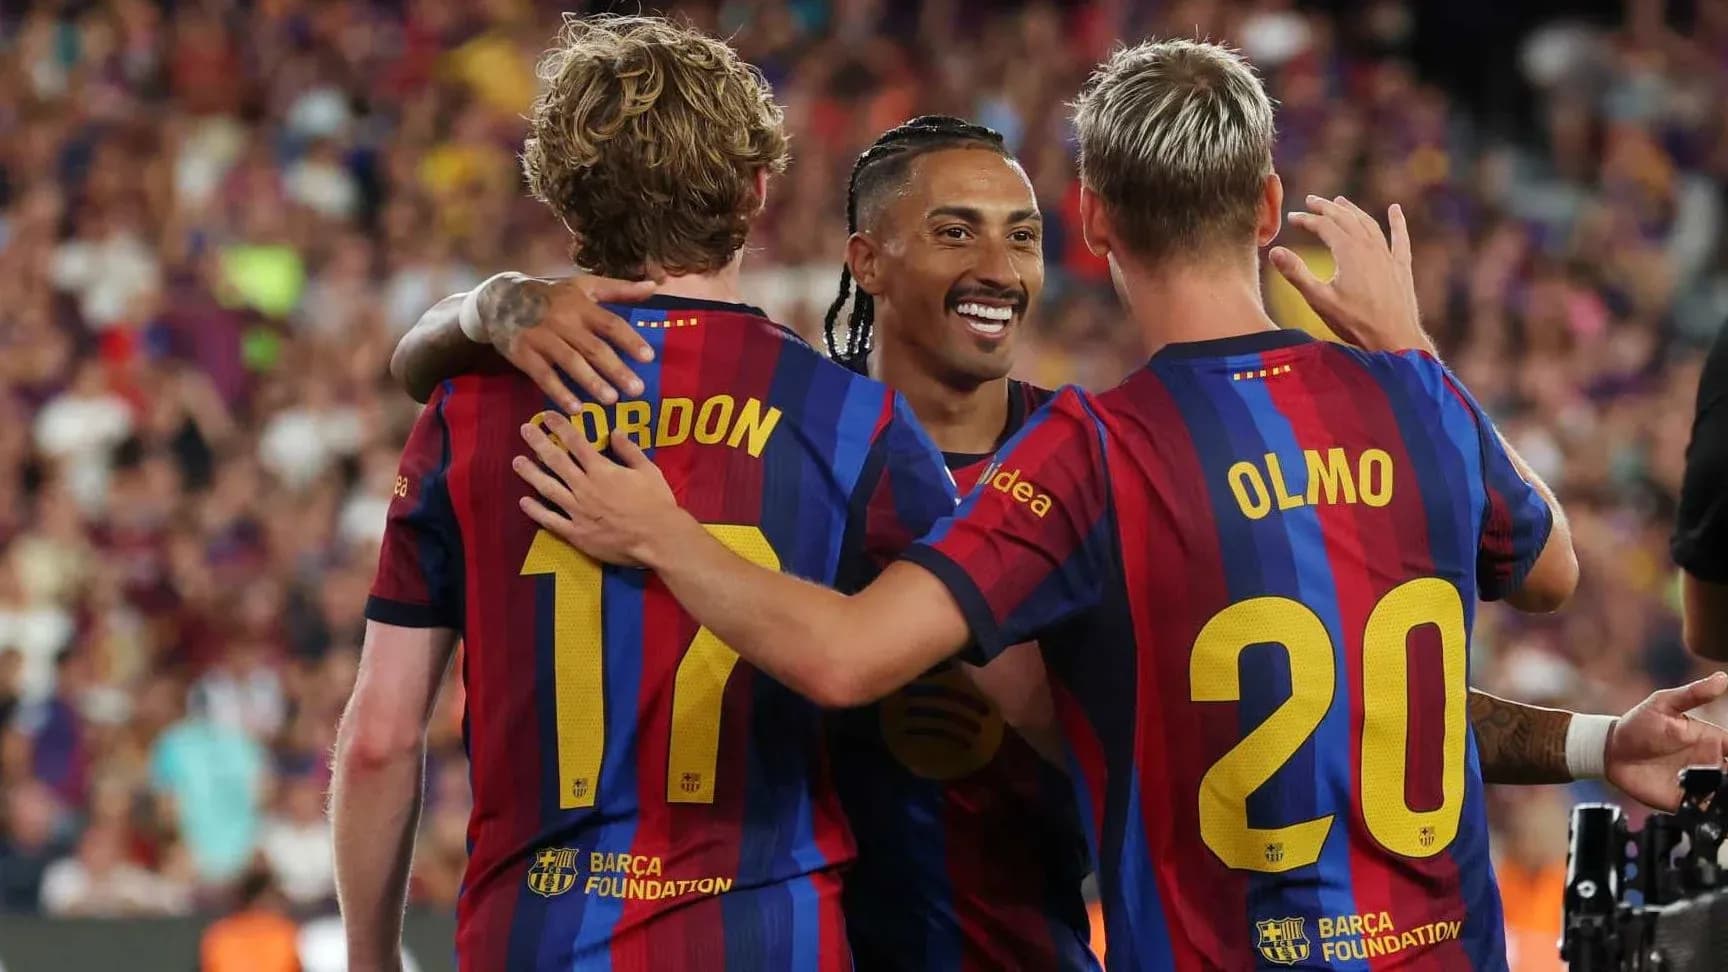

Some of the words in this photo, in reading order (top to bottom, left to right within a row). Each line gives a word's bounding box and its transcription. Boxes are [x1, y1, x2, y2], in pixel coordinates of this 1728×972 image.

[977, 463, 1052, 518] idea
[1227, 446, 1394, 520] OLMO
[519, 523, 781, 810] 17
[1189, 576, 1466, 873] 20
[584, 876, 732, 901] FOUNDATION
[590, 851, 662, 878] BARÇA
[1318, 911, 1394, 938] BARÇA
[1322, 920, 1462, 962] FOUNDATION
